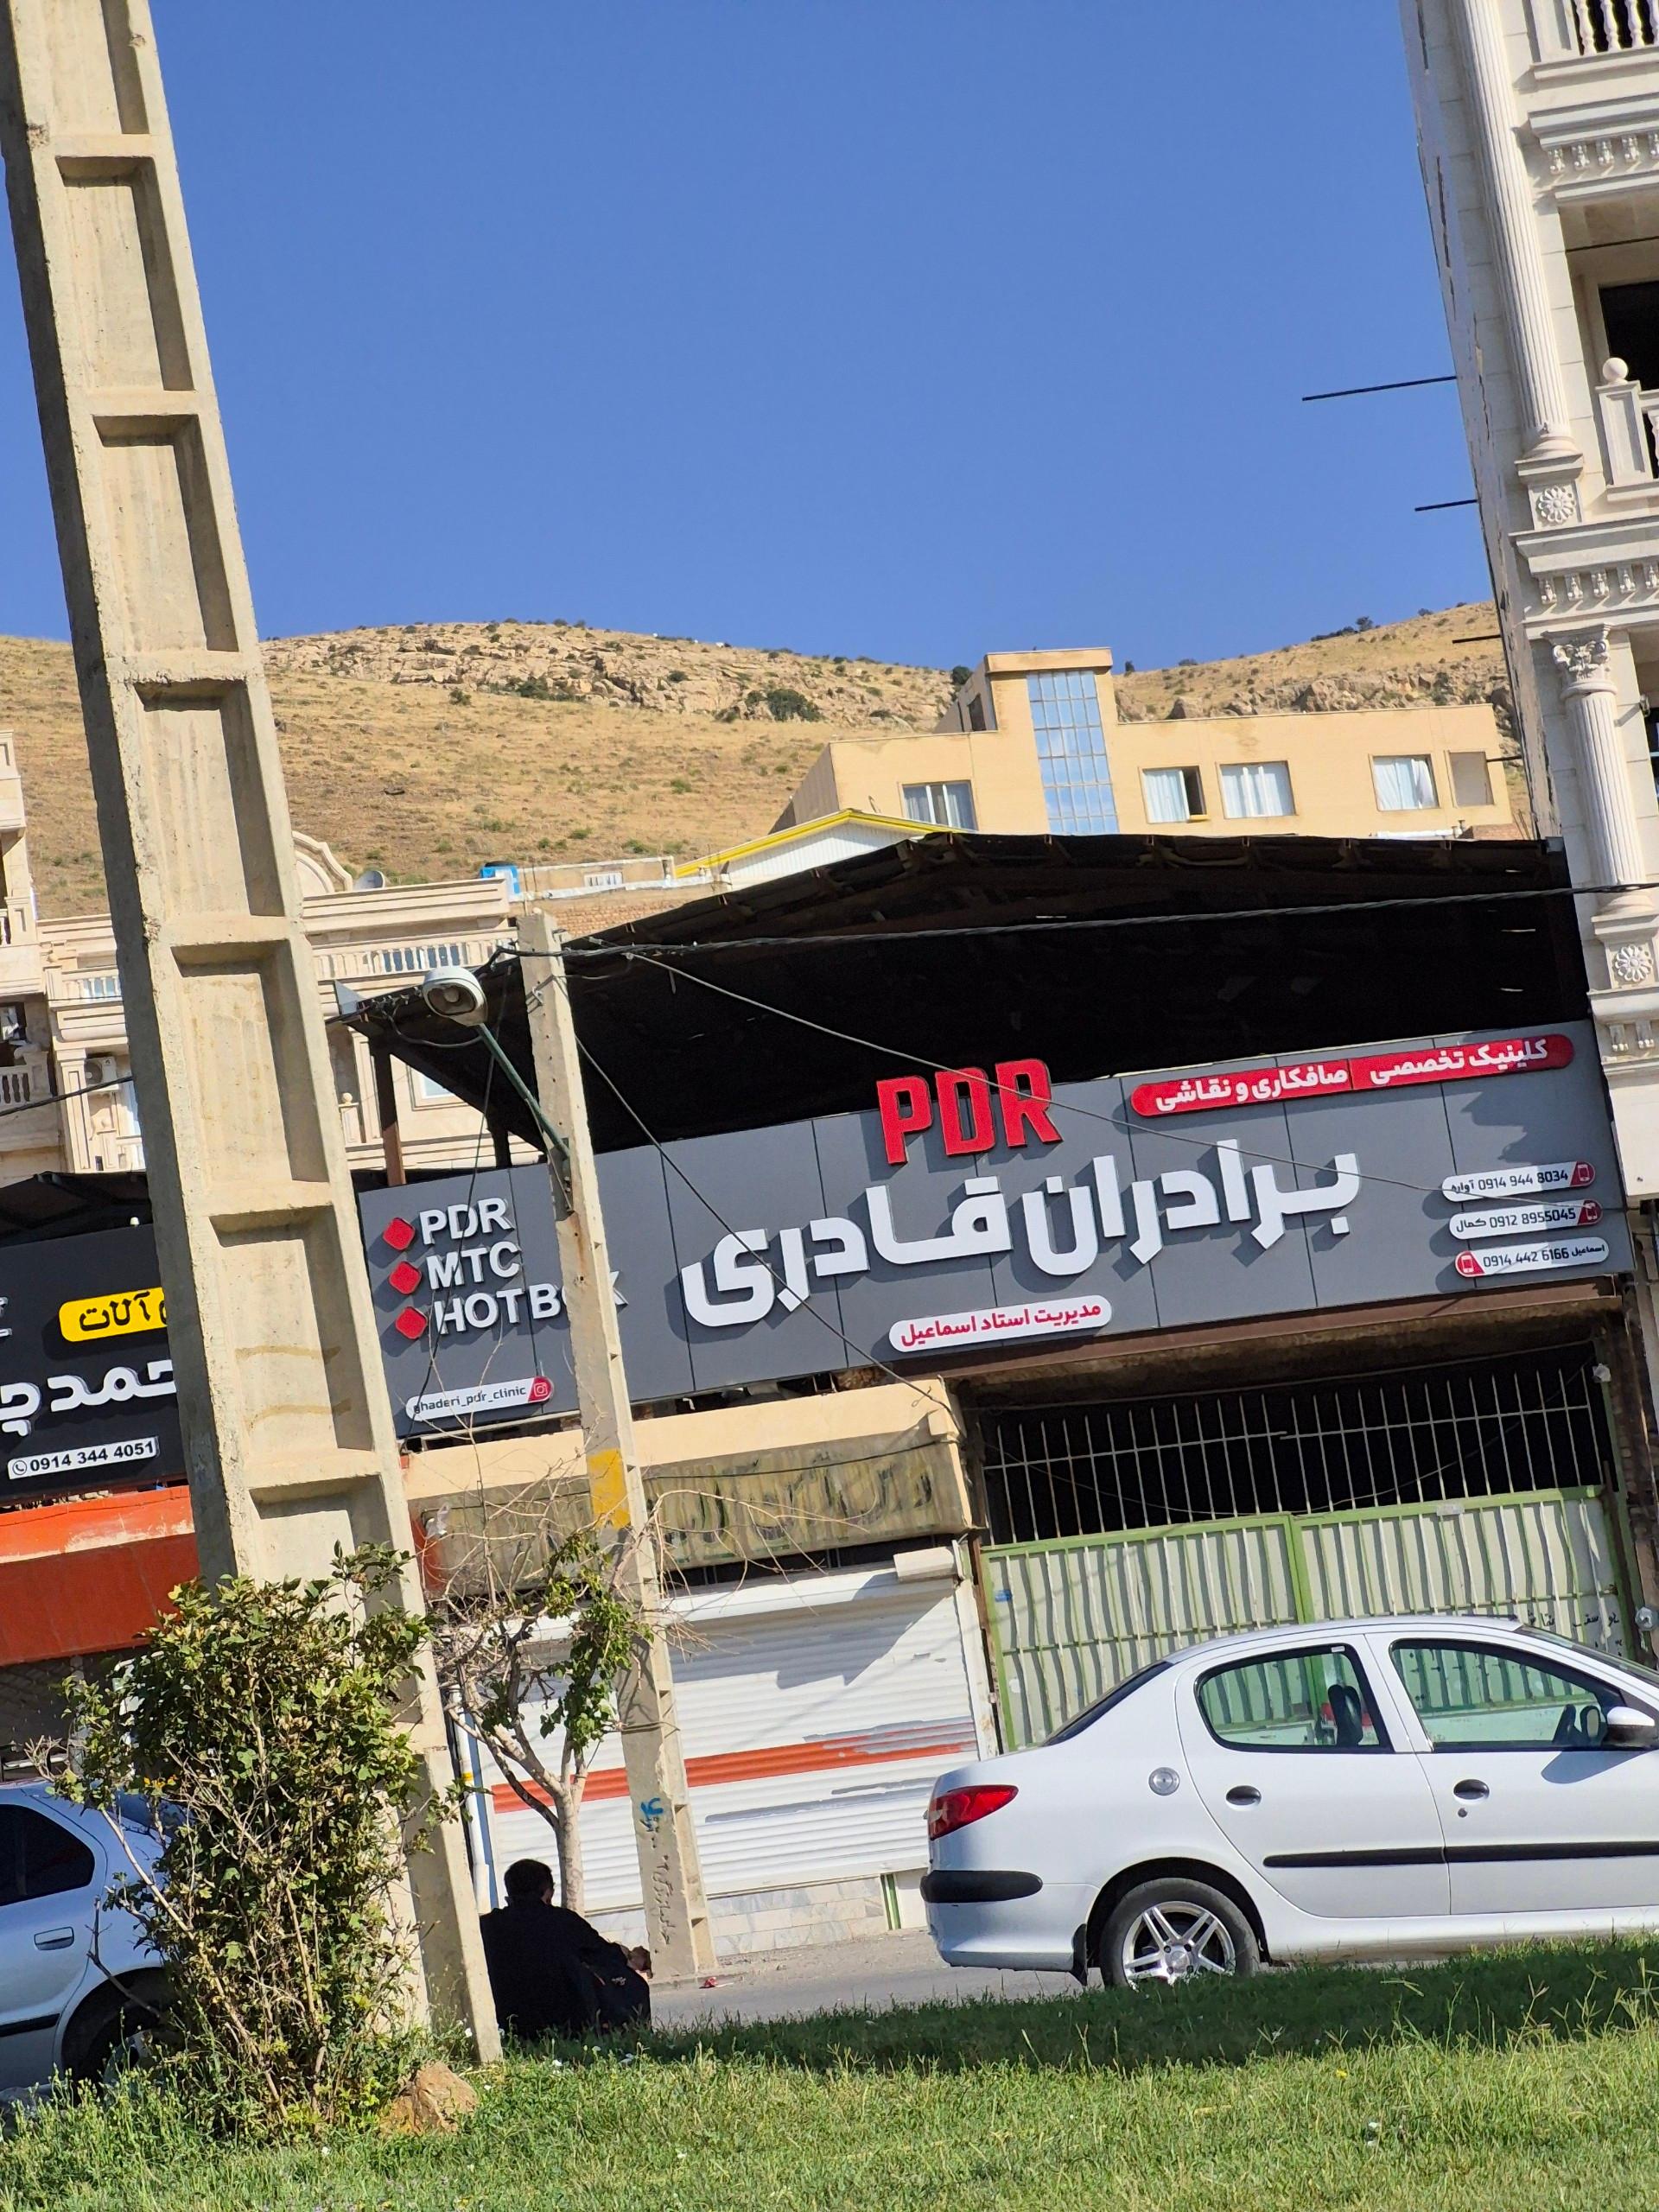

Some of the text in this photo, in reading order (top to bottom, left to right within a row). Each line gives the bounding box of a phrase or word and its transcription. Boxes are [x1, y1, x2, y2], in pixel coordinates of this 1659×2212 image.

[1155, 1039, 1548, 1111] کلینیک تخصصی صافکاری و نقاشی
[876, 1058, 1063, 1165] PDR
[1478, 1176, 1507, 1191] 0914
[1510, 1173, 1534, 1186] 944
[1537, 1170, 1569, 1184] 8034
[419, 1198, 515, 1245] PDR
[681, 1138, 1361, 1327] برادران قادری
[1456, 1218, 1487, 1232] کمال
[1489, 1215, 1518, 1228] 0912
[426, 1241, 522, 1290] MTC
[1483, 1244, 1605, 1268] 0914 442 6166 اسماعیل
[79, 1290, 150, 1332] آلات
[434, 1271, 628, 1334] HOTB
[900, 1303, 1102, 1346] مدیریت استاد اسماعیل
[47, 1359, 176, 1412] حمد
[29, 1441, 154, 1472] 0914 344 4051
